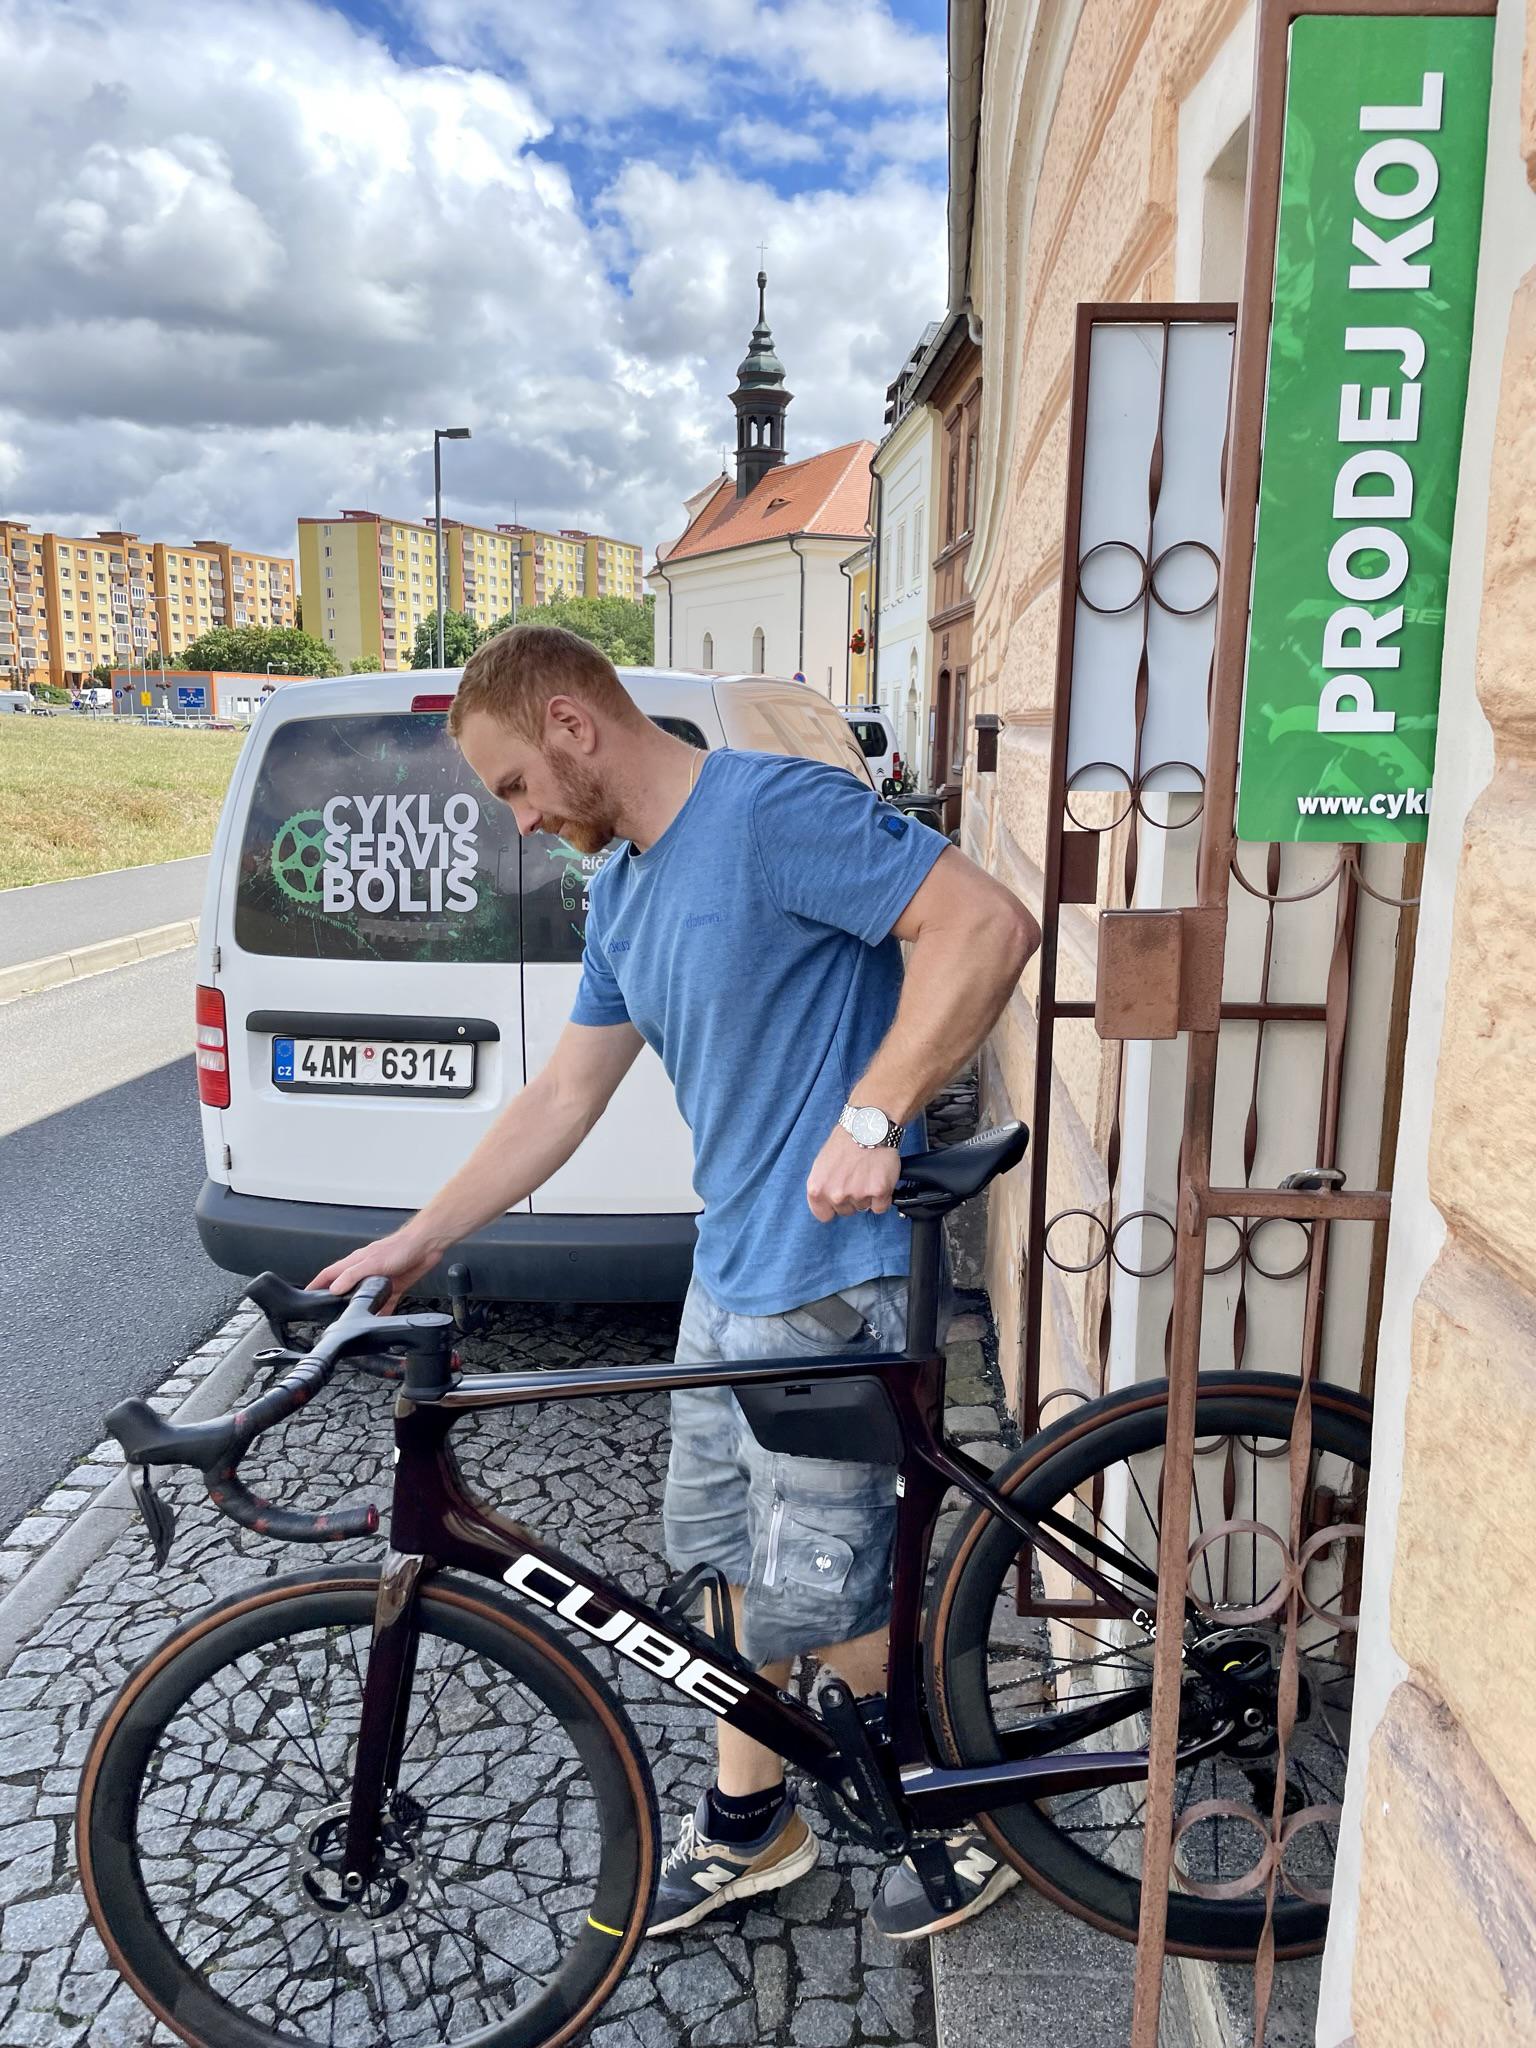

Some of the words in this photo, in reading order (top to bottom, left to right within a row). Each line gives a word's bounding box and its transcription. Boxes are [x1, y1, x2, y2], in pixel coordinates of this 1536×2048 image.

[1349, 72, 1444, 289] KOL
[1317, 327, 1426, 732] PRODEJ
[323, 793, 480, 834] CYKLO
[322, 832, 479, 870] SERVIS
[582, 856, 608, 870] ŘÍČ
[323, 867, 479, 913] BOLIS
[277, 1066, 292, 1076] CZ
[301, 1044, 357, 1079] 4AM
[381, 1047, 456, 1082] 6314
[502, 1553, 750, 1715] CUBE
